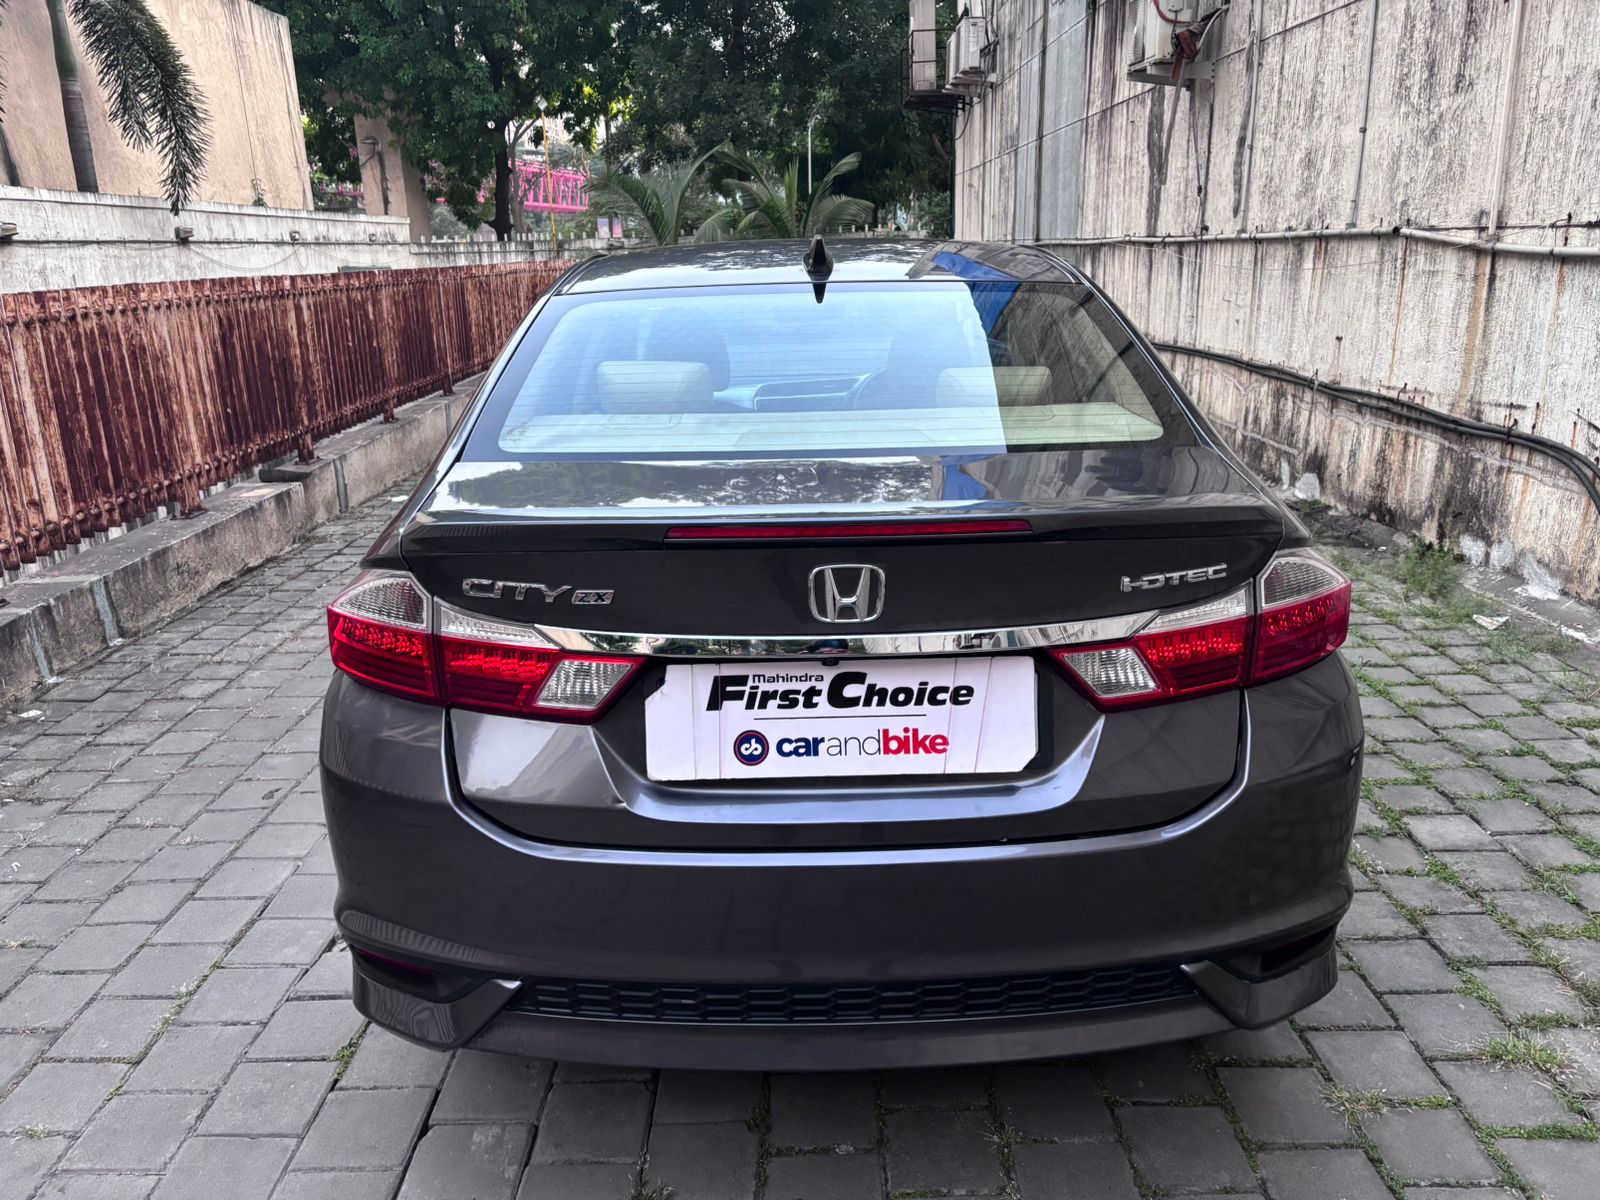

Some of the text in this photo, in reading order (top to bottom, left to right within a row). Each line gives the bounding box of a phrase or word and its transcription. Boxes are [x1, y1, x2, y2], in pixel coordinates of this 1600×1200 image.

[462, 578, 609, 604] CITY ZX
[706, 671, 975, 711] First Choice
[752, 673, 824, 684] Mahindra
[776, 726, 950, 757] carandbike
